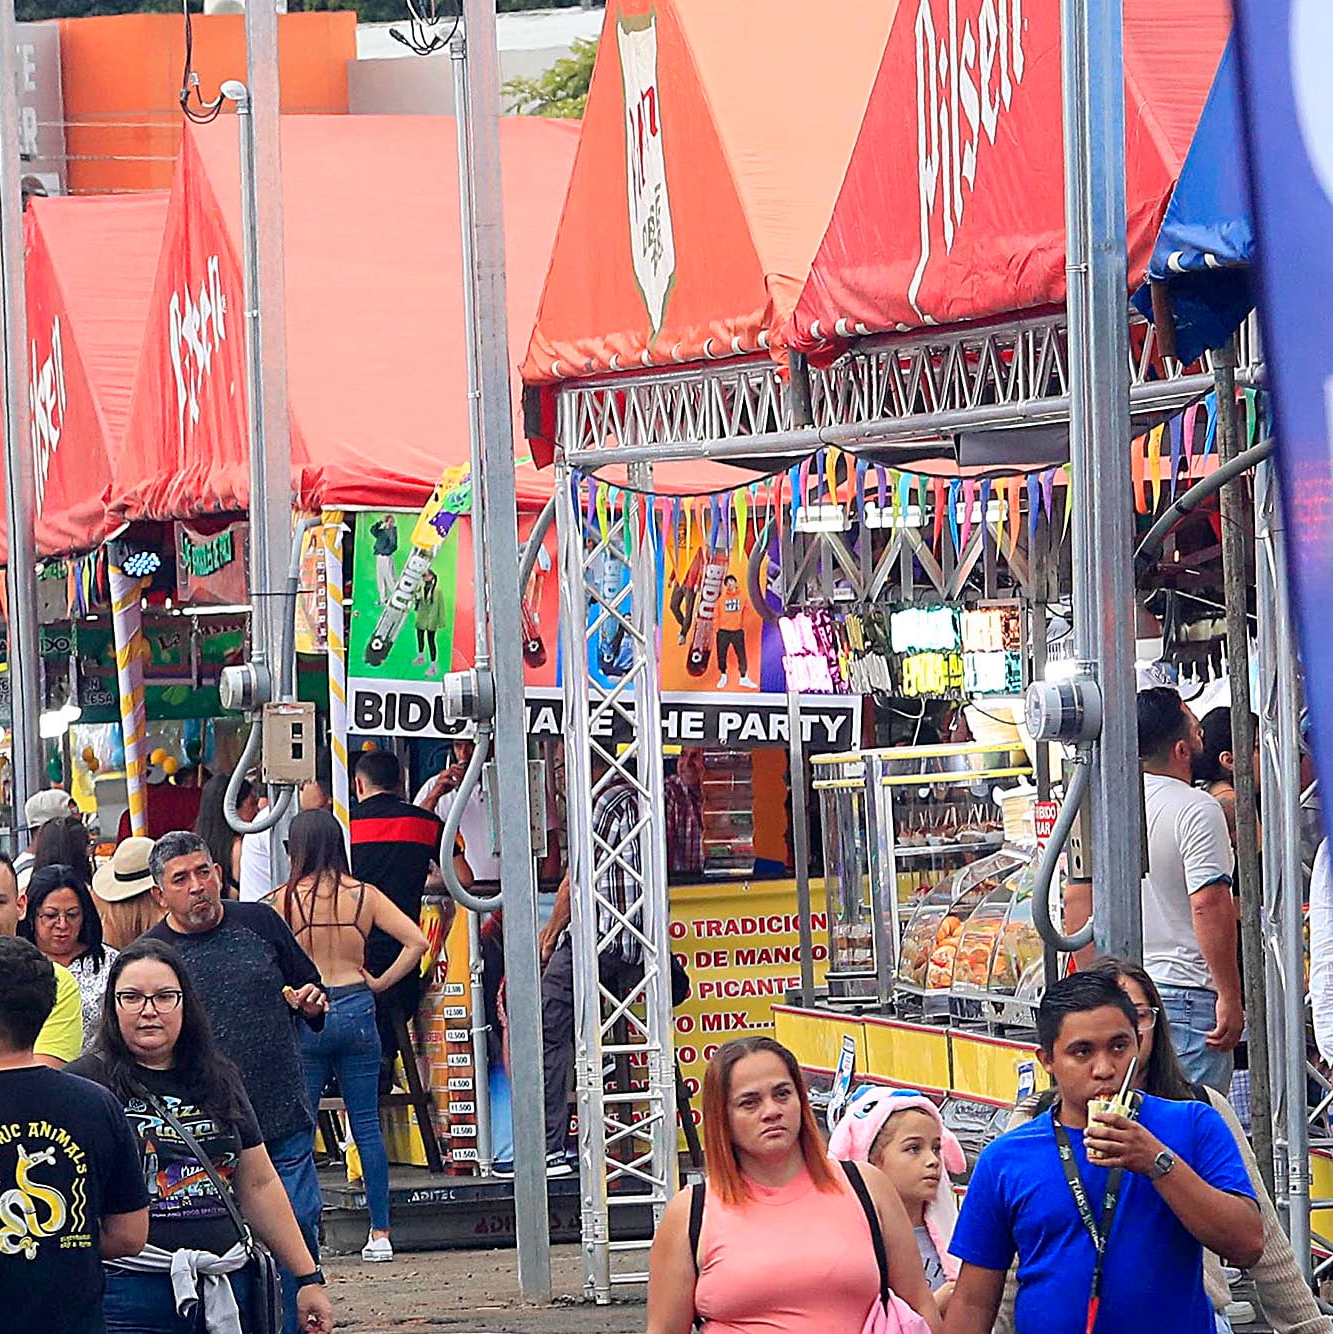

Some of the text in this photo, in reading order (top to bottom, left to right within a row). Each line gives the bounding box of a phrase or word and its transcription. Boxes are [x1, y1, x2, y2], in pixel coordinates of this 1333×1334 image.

[719, 710, 846, 745] PARTY
[695, 951, 727, 969] DE
[699, 976, 802, 1000] PICANTE
[28, 1120, 88, 1175] ANIMALS
